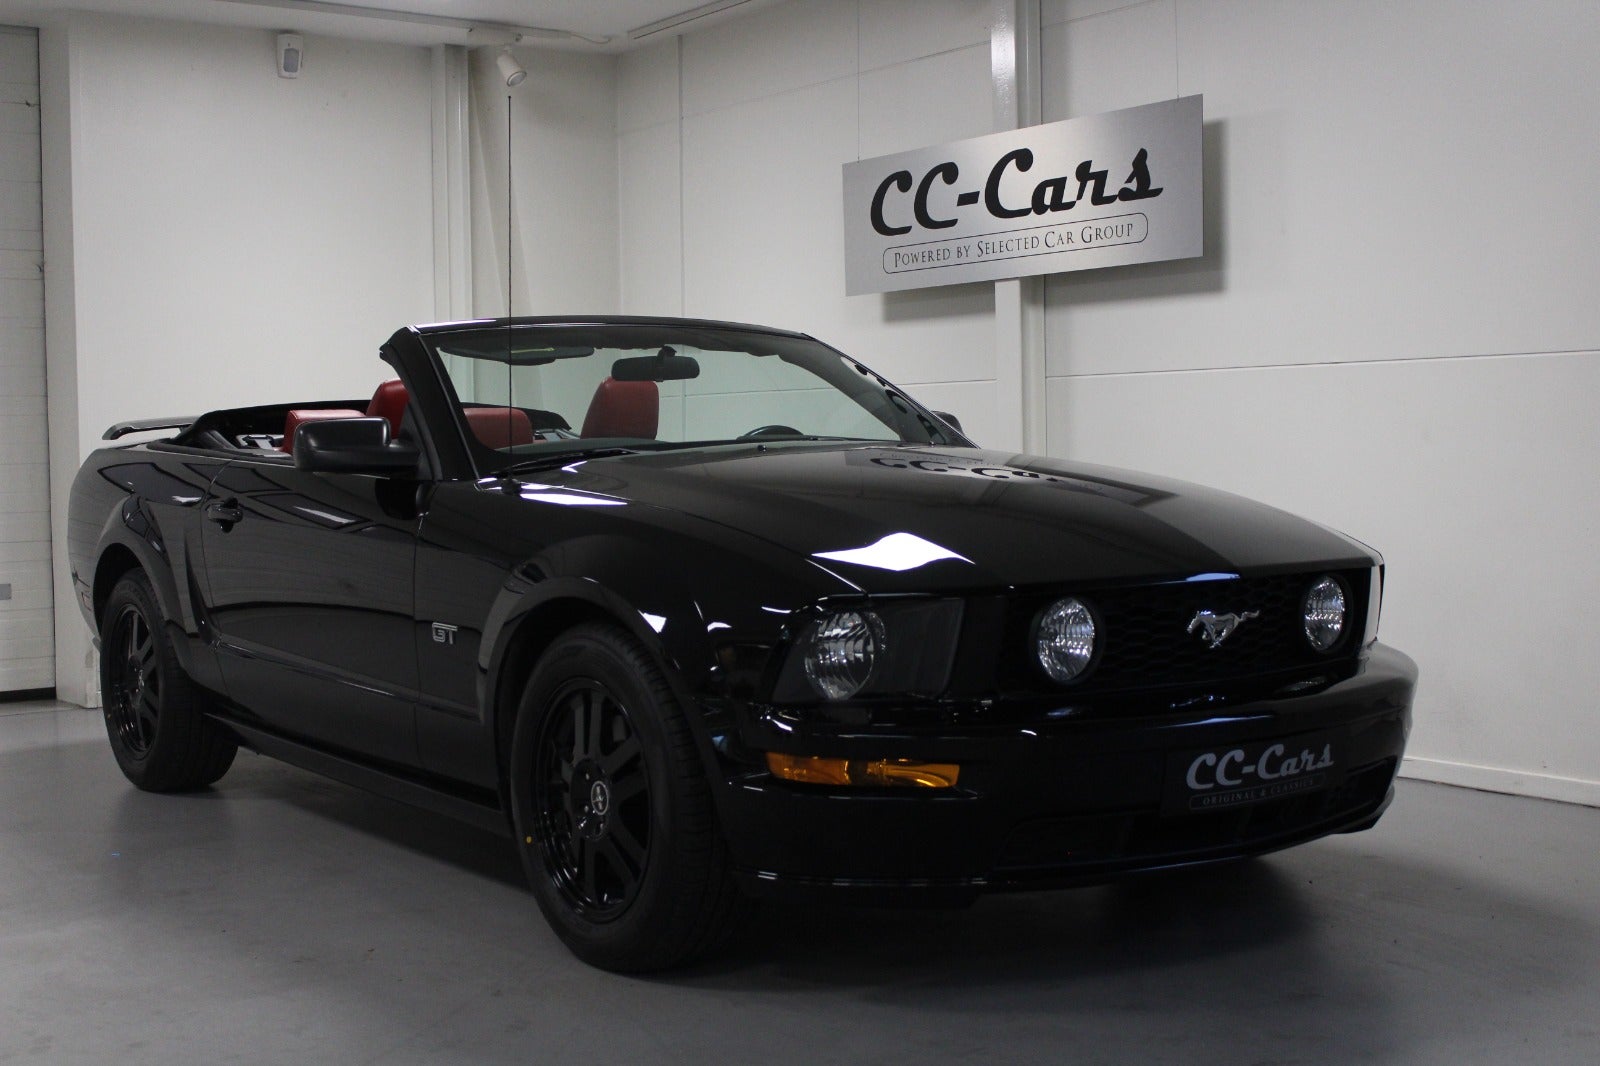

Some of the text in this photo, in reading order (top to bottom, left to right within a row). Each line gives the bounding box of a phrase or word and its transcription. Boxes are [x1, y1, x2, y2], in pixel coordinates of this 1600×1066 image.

[870, 148, 1164, 236] CC-Cars
[894, 223, 1133, 268] POWERED BY SELECTED CAR GROUP
[432, 622, 458, 645] GT
[1186, 743, 1335, 790] CC-Cars
[1202, 790, 1255, 806] ORIGINAL
